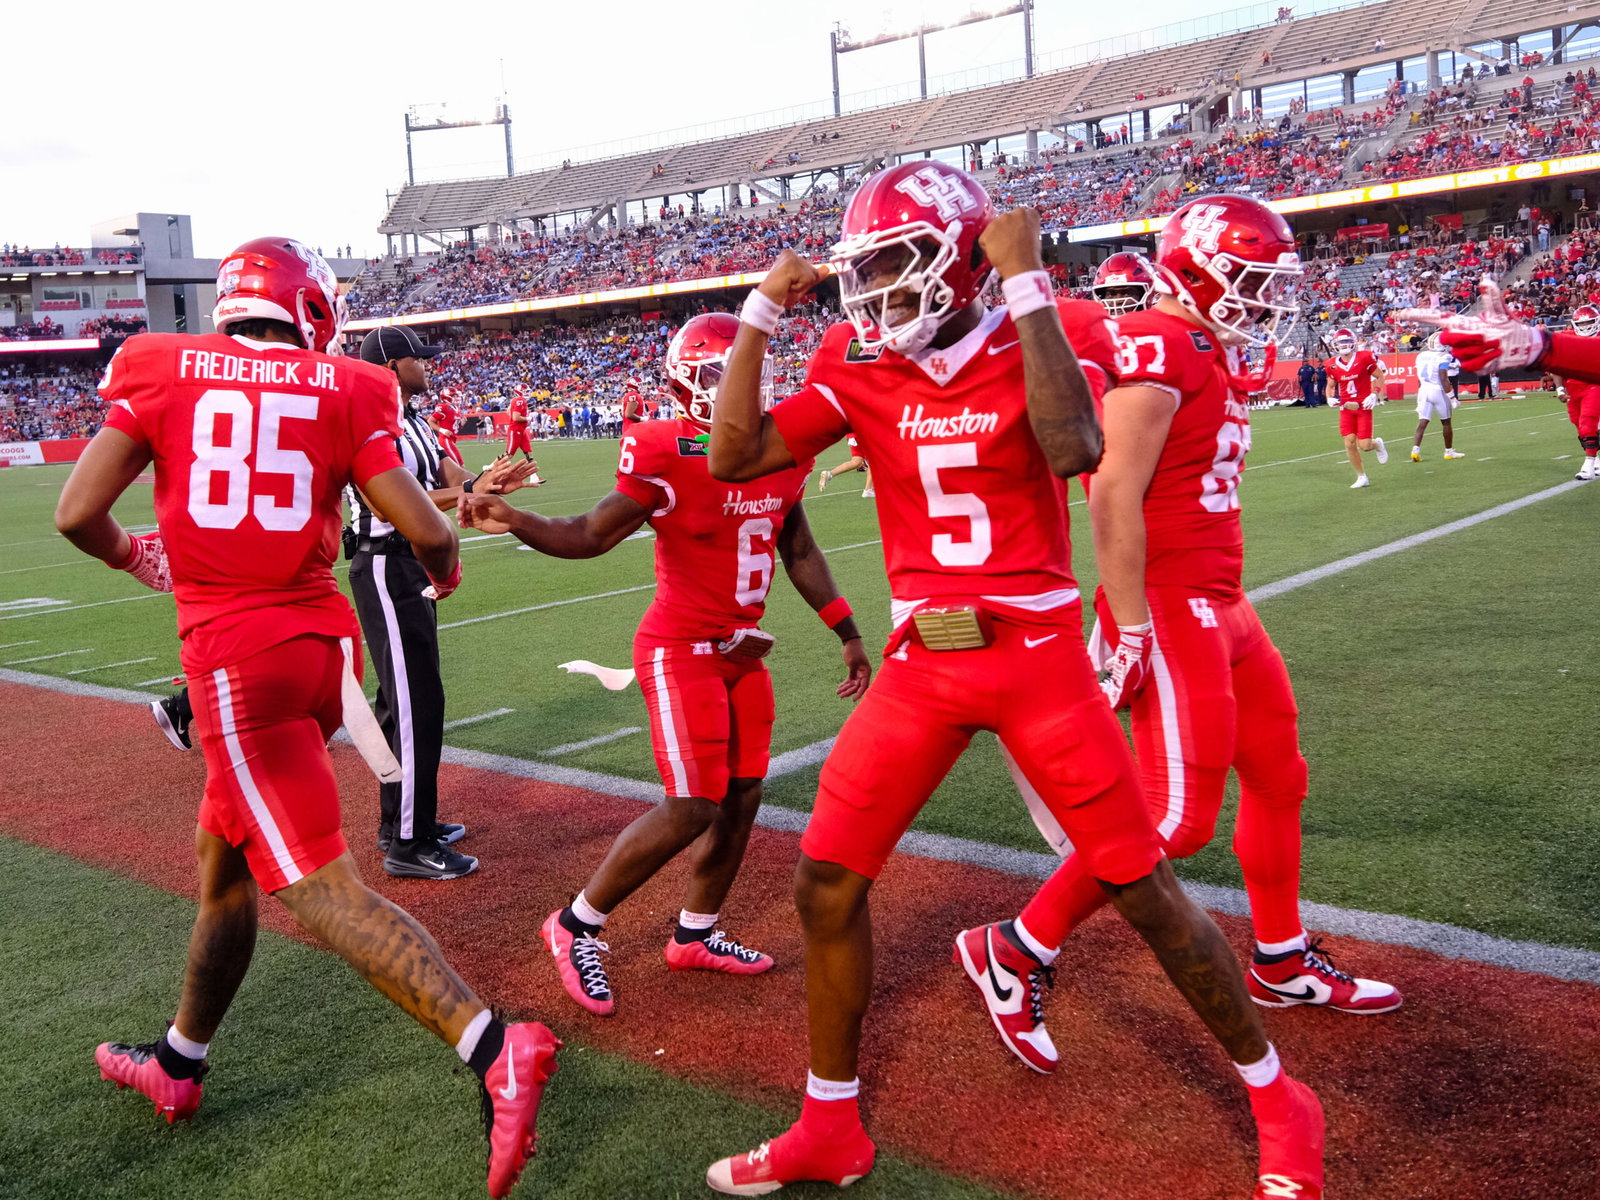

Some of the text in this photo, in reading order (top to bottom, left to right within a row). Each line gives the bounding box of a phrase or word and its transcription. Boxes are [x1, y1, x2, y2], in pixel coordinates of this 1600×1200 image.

[180, 349, 340, 392] FREDERICK JR.
[896, 403, 999, 440] Houston
[187, 389, 320, 532] 85
[618, 436, 637, 475] 6
[722, 489, 783, 516] Houston
[916, 441, 993, 567] 5
[735, 517, 773, 607] 6
